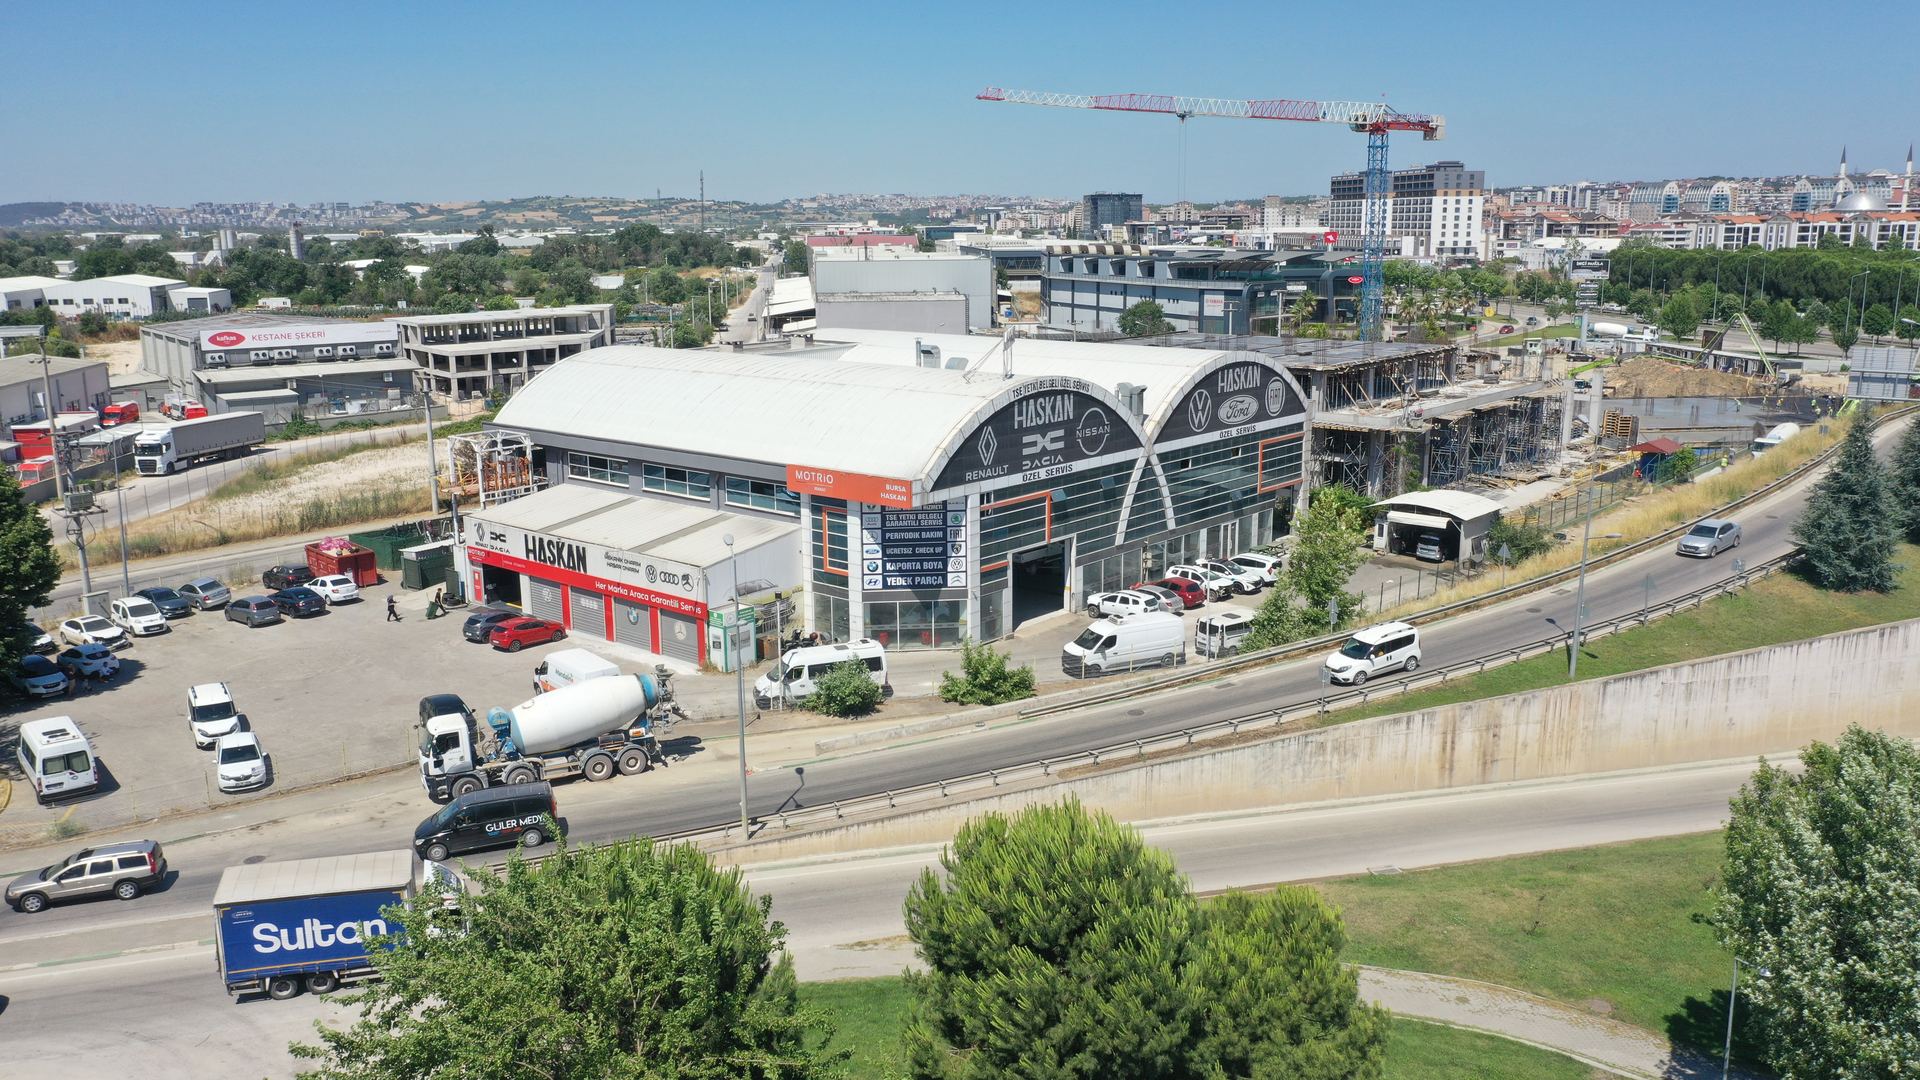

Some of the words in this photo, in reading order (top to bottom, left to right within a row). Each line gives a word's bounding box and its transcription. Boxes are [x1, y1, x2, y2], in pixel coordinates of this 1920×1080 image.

[251, 332, 293, 342] KESTANE
[294, 331, 326, 341] ŞEKERİ
[1218, 365, 1261, 394] HASKAN
[1013, 387, 1023, 399] TSE
[1014, 393, 1074, 430] HASKAN
[1225, 400, 1251, 420] Ford
[1076, 424, 1111, 439] NISSAN
[1235, 424, 1257, 436] SERVİS
[1022, 454, 1064, 470] DACIA
[965, 465, 1009, 482] RENAULT
[1022, 472, 1042, 482] ÖZEL
[1045, 465, 1073, 477] SERVİS
[885, 483, 907, 493] BURSA
[880, 492, 907, 502] HASKAN
[921, 531, 943, 540] BAKIM
[524, 533, 587, 575] HASKAN
[915, 545, 934, 554] CHECK
[886, 561, 921, 571] KAPORTA
[923, 561, 943, 570] BOYA
[885, 577, 913, 586] YEDEK
[914, 576, 943, 587] PARÇA
[595, 581, 606, 590] Her
[607, 584, 628, 596] Marka
[629, 589, 649, 601] Araca
[519, 814, 548, 826] MEDY
[252, 918, 387, 954] Sultan
